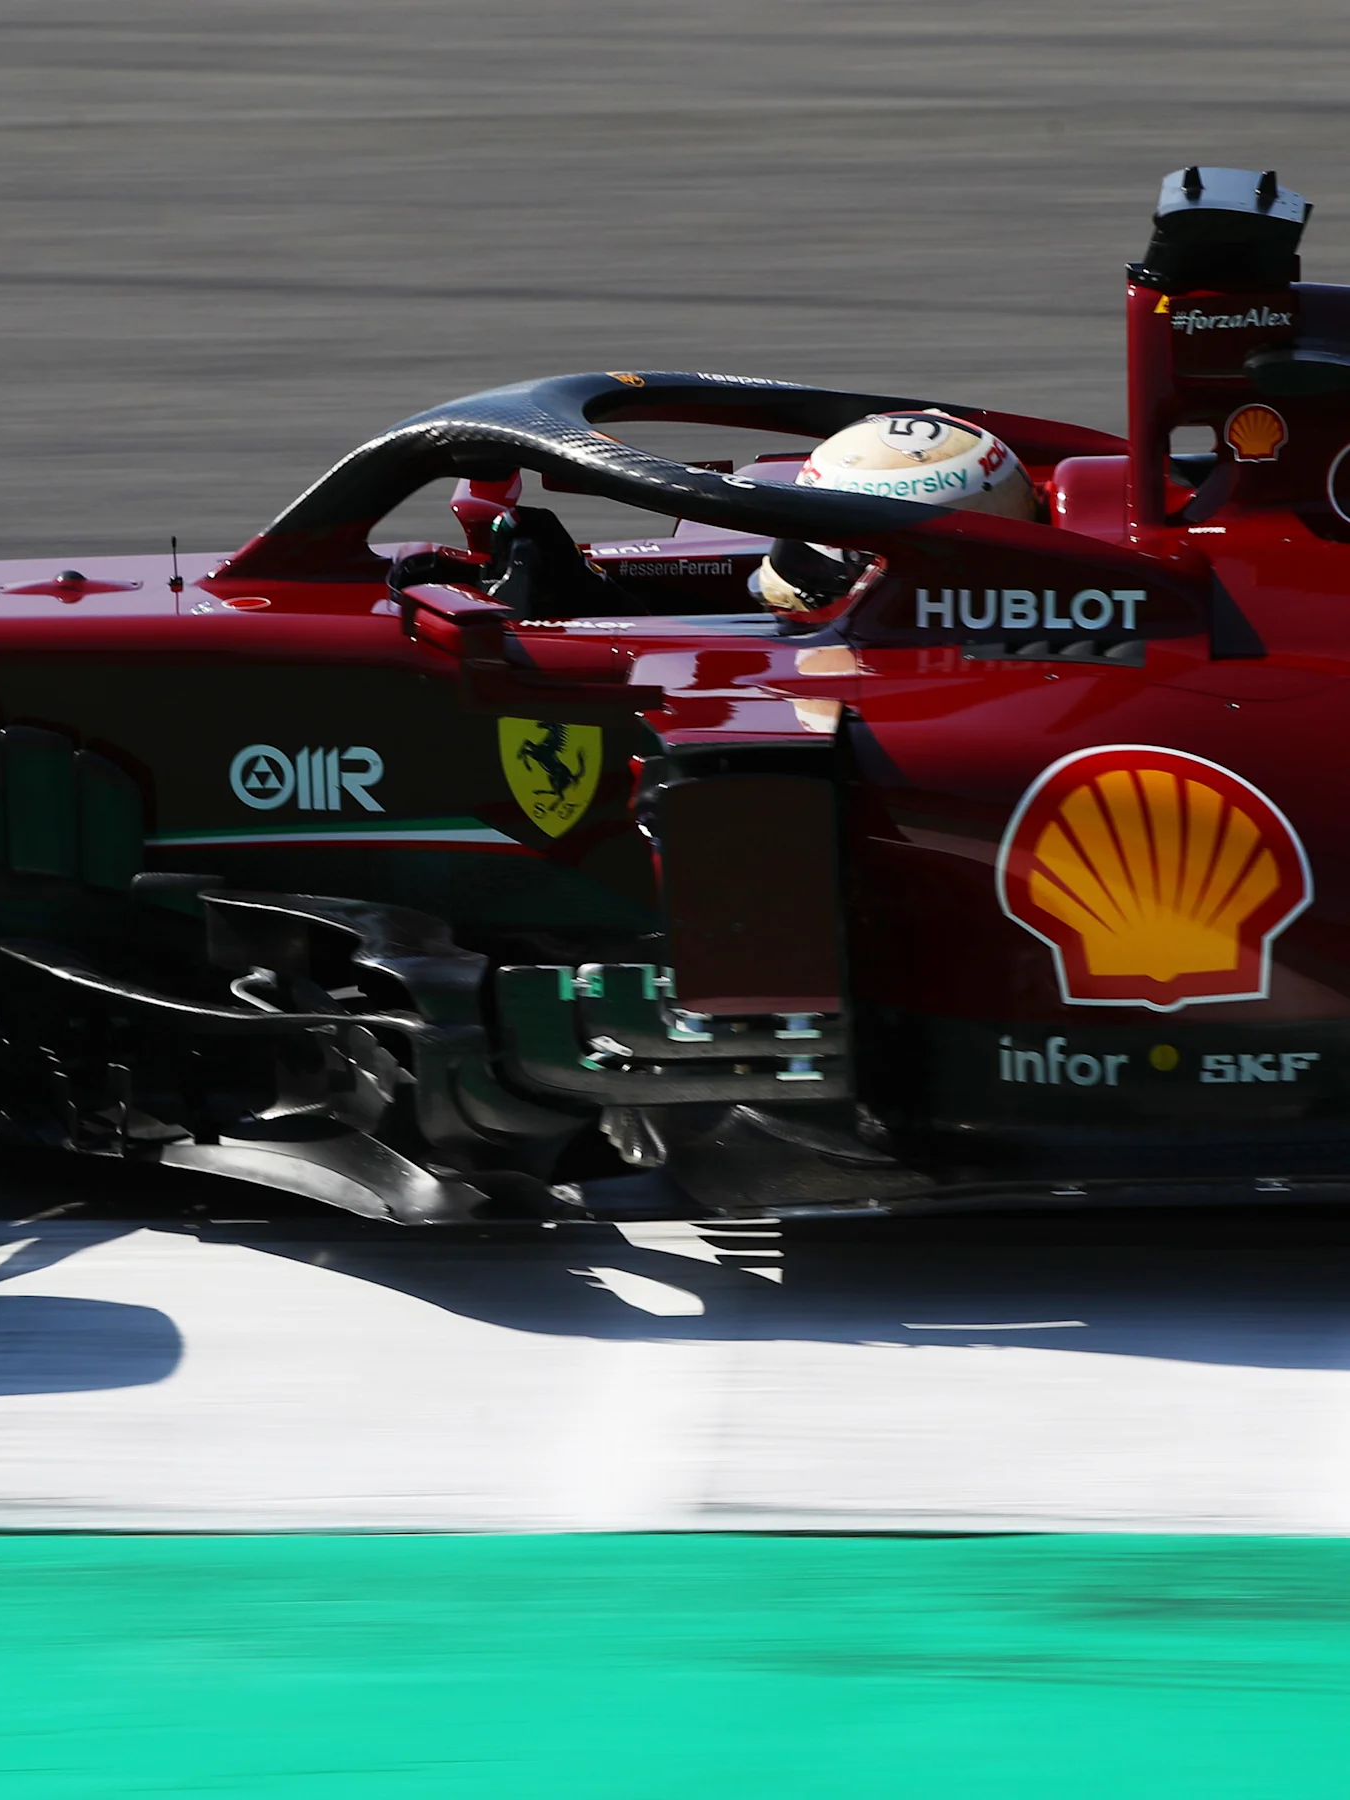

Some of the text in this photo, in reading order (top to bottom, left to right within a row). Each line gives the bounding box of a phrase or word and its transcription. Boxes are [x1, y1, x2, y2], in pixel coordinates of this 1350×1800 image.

[1171, 306, 1292, 335] #forzaAlex
[888, 416, 941, 441] 5
[618, 558, 733, 577] #essereFerrari
[916, 588, 1147, 630] HUBLOT
[999, 1034, 1130, 1086] infor
[1199, 1052, 1321, 1083] SKF
